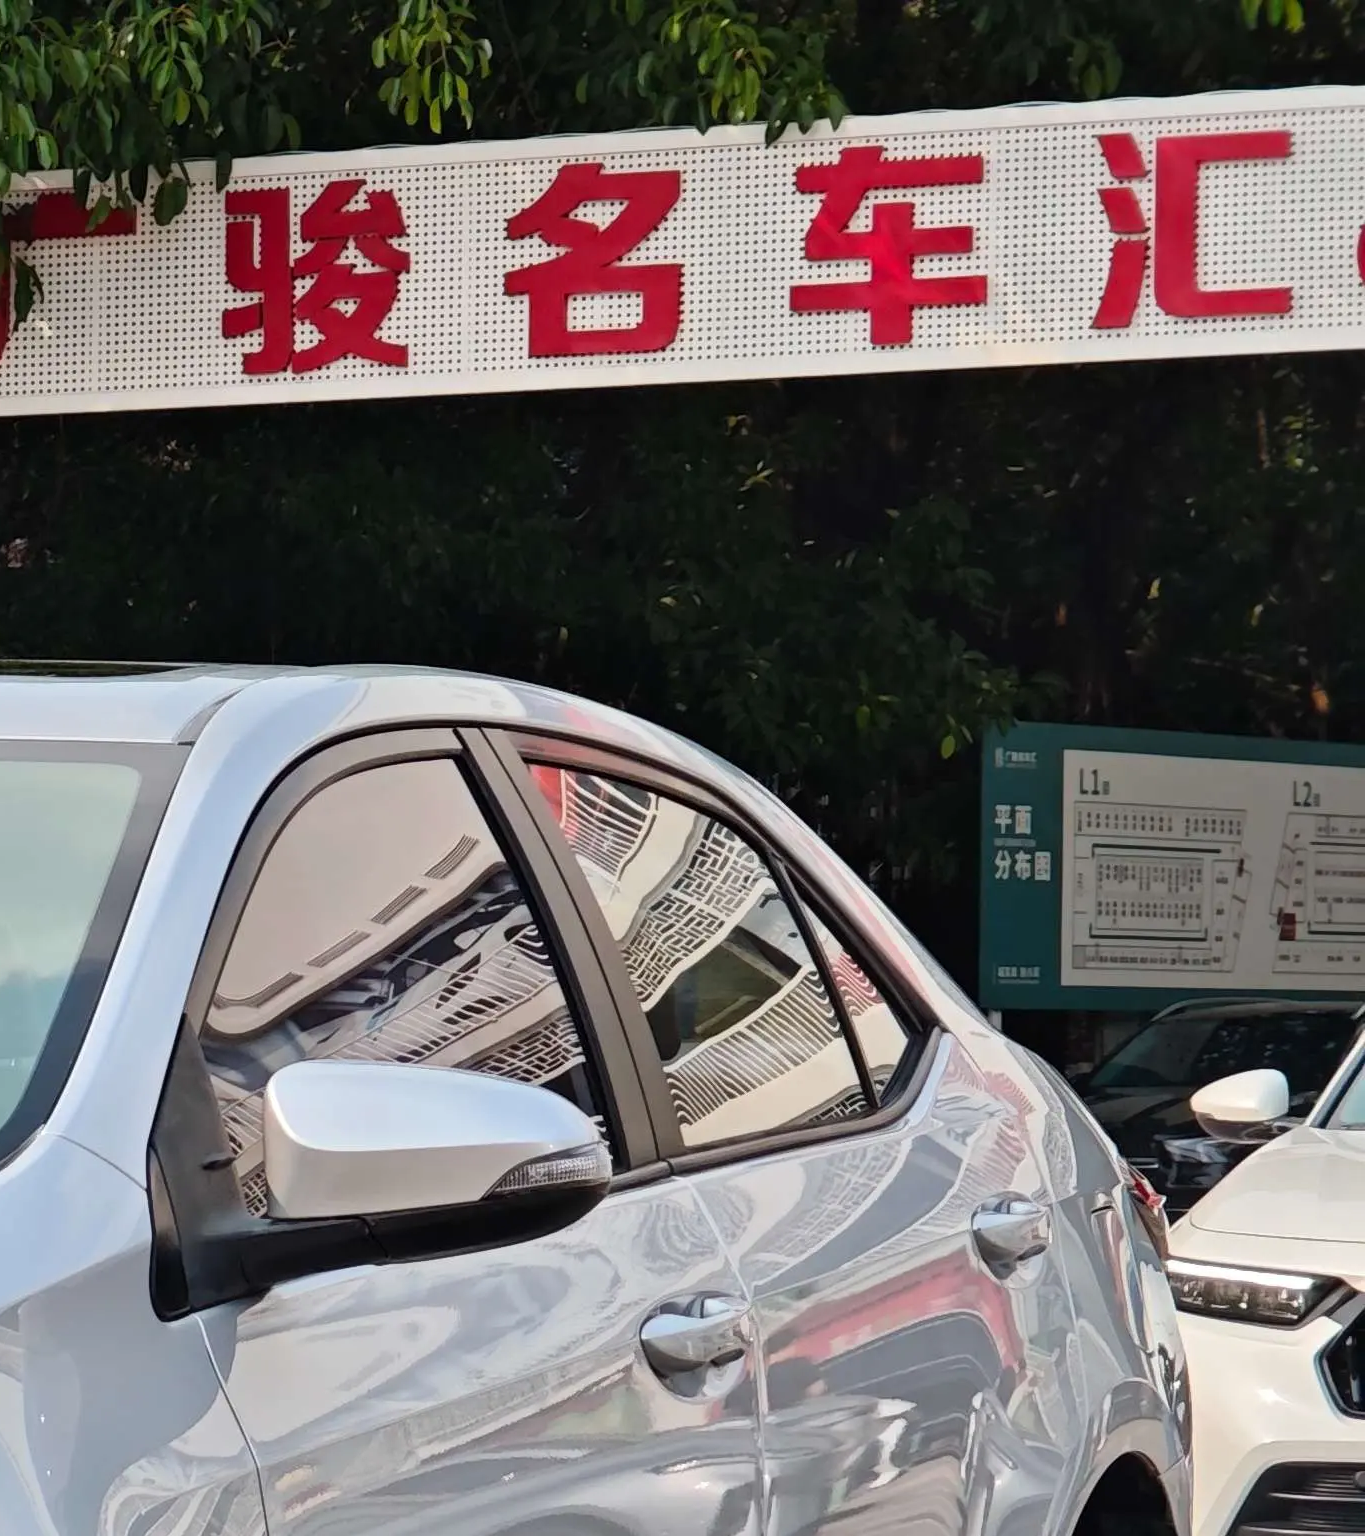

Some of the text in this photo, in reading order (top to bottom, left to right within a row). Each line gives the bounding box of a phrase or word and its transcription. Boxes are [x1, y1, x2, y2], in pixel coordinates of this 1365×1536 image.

[994, 804, 1033, 835] 平面
[994, 850, 1051, 881] 分布图
